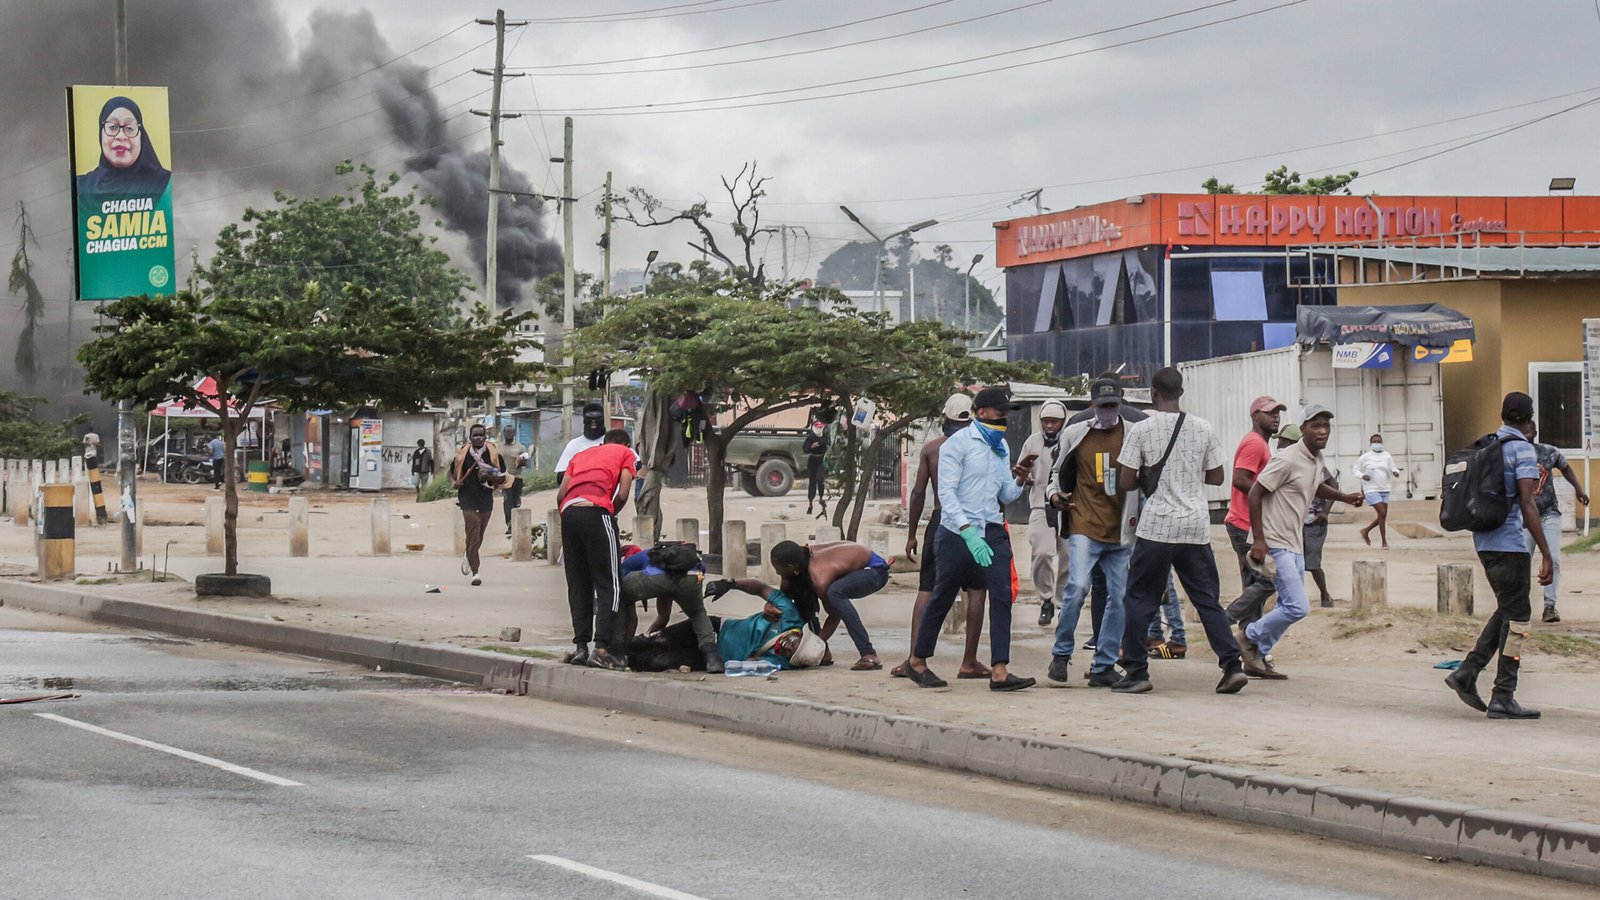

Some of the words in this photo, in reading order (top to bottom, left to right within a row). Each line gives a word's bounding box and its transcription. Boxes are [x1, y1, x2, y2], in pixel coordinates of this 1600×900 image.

[102, 198, 153, 214] CHAGUA
[86, 210, 167, 239] SAMIA
[1220, 205, 1327, 236] HAPPY
[1335, 206, 1442, 236] NATION
[86, 238, 138, 254] CHAGUA
[139, 235, 168, 249] CCM
[1336, 350, 1358, 358] NMB
